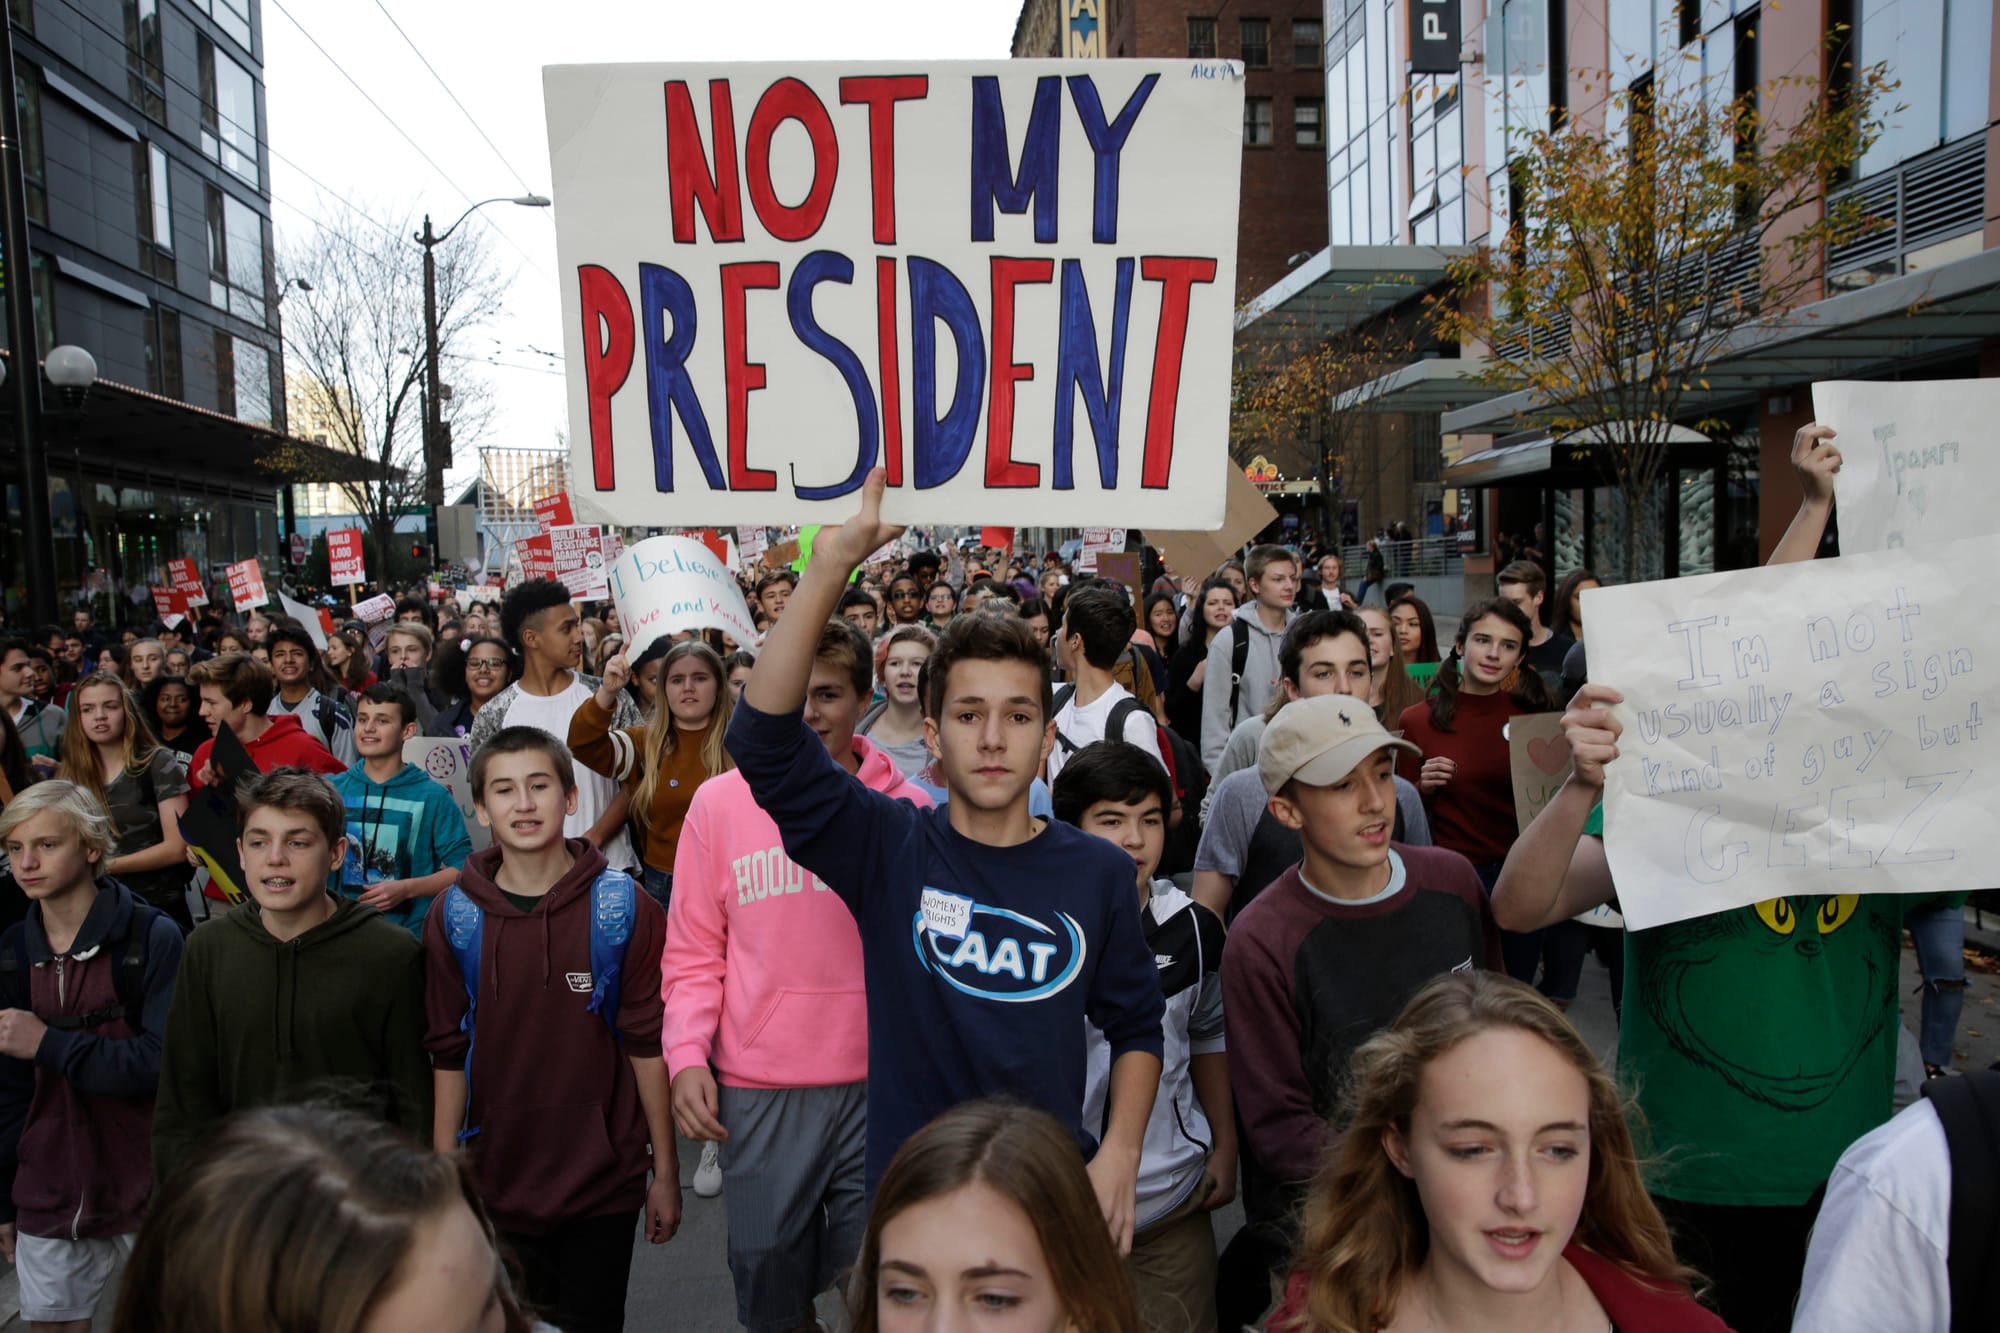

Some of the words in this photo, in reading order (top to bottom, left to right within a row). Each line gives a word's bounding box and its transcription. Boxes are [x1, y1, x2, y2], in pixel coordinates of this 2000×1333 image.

[664, 74, 929, 245] NOT
[970, 72, 1161, 244] MY
[577, 249, 1218, 500] PRESIDENT
[328, 533, 350, 546] BUILD
[516, 540, 528, 551] NO
[552, 529, 575, 541] BUILD
[576, 528, 591, 538] THE
[553, 538, 599, 551] RESISTANCE
[555, 549, 586, 560] AGAINST
[556, 560, 583, 571] TRUMP
[612, 566, 626, 600] I
[633, 548, 721, 583] believe
[623, 608, 661, 641] love
[671, 598, 705, 615] and
[1667, 615, 1770, 691] I'm
[1807, 586, 1921, 663] not
[1637, 684, 1792, 745] usually
[1819, 680, 1845, 707] a
[1871, 646, 1974, 701] sign
[1744, 742, 1776, 781] of
[1801, 728, 1894, 786] guy
[1917, 701, 1984, 752] but
[1683, 768, 1974, 885] GEEZ
[732, 845, 804, 906] HOOD
[922, 894, 965, 917] WOMEN'S
[925, 908, 956, 928] RIGHTS
[1154, 954, 1173, 965] NIKE
